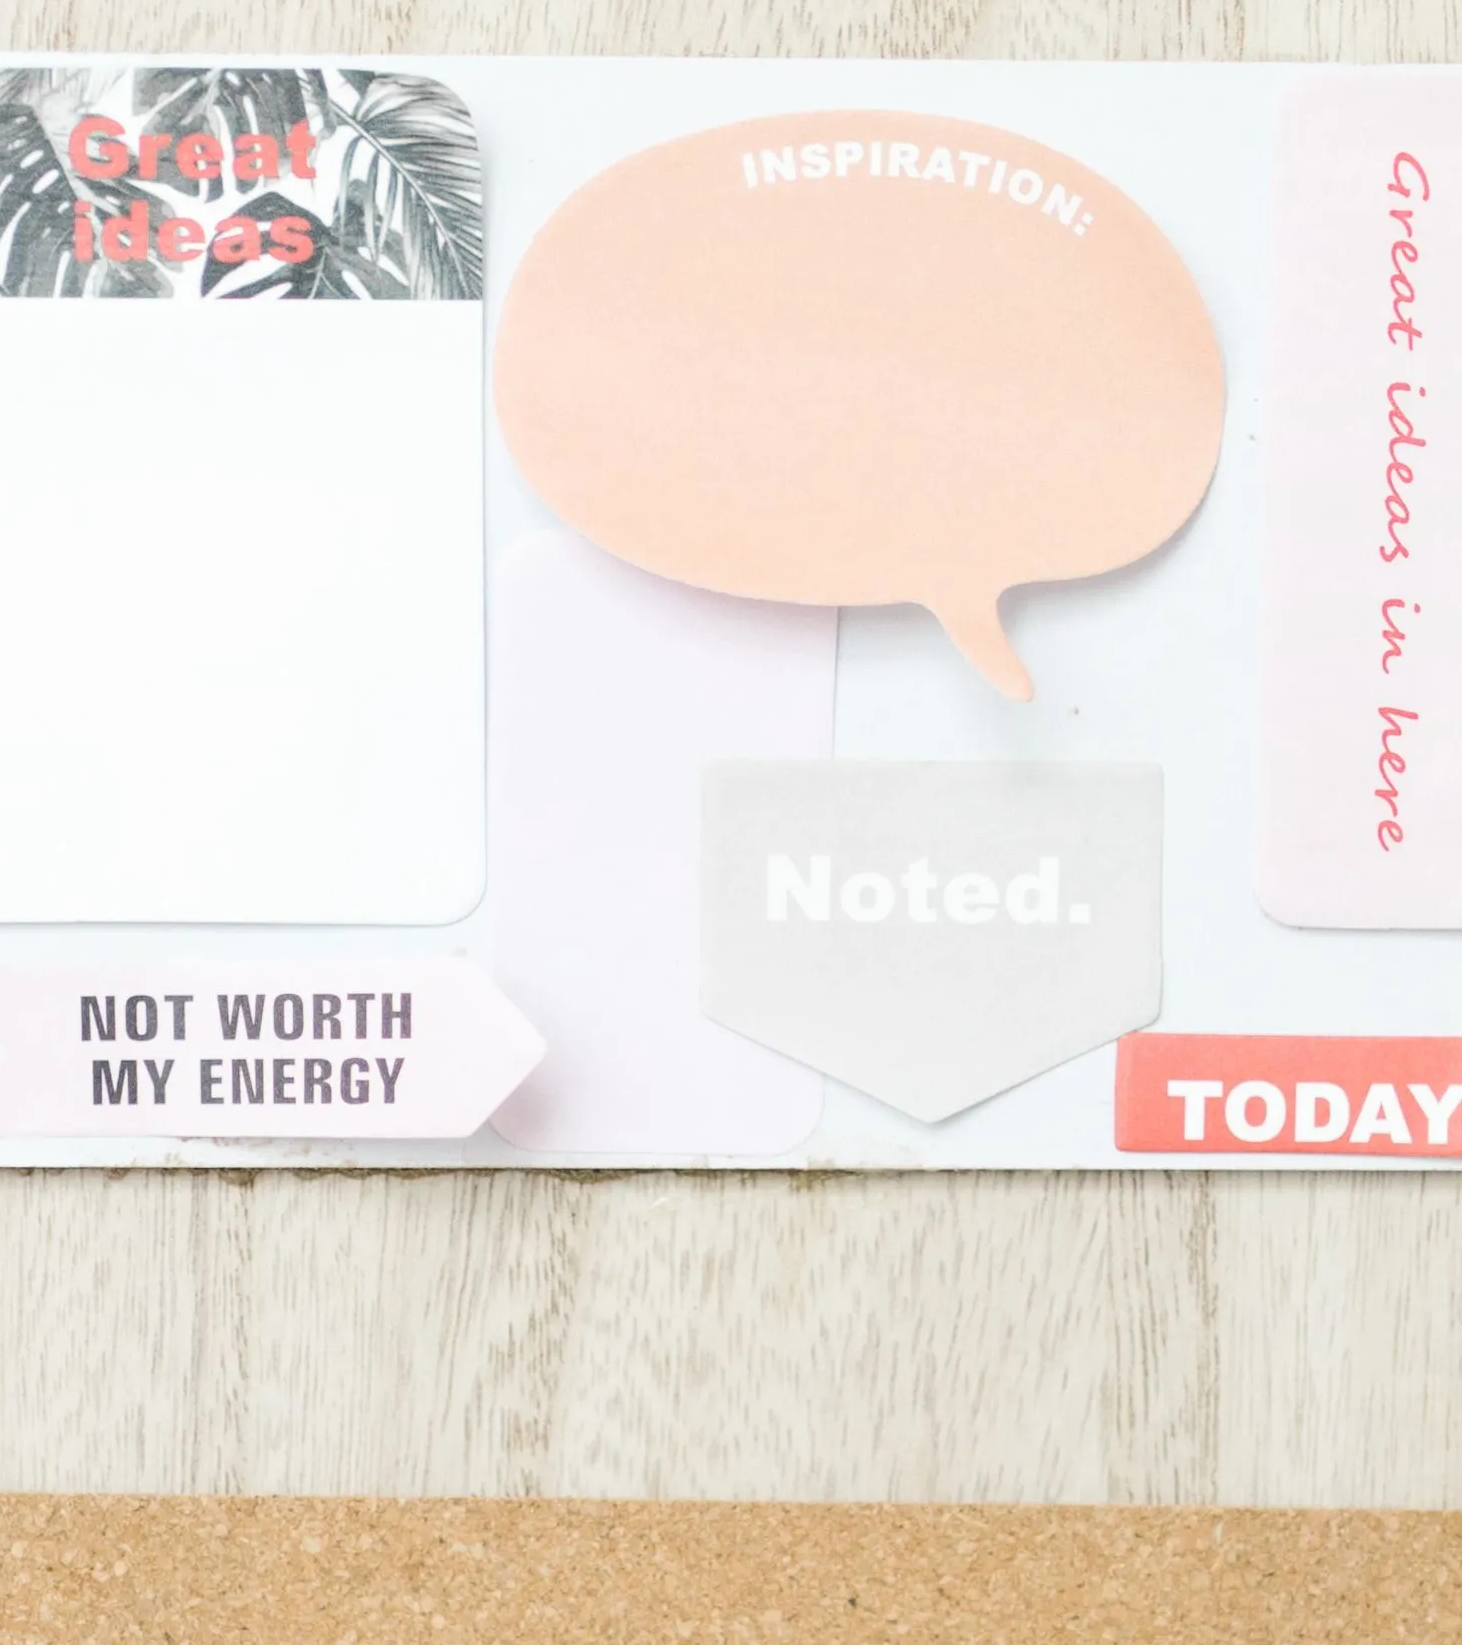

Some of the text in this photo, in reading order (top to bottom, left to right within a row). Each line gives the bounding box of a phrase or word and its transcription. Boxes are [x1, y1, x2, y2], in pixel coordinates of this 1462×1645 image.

[68, 115, 317, 181] Great
[741, 140, 1095, 237] INSPIRATION:
[72, 198, 315, 265] ideas
[1372, 150, 1432, 854] Great ideas in here
[765, 853, 1092, 926] Noted.
[79, 991, 413, 1043] NOT WORTH
[91, 1056, 406, 1106] MY ENERGY
